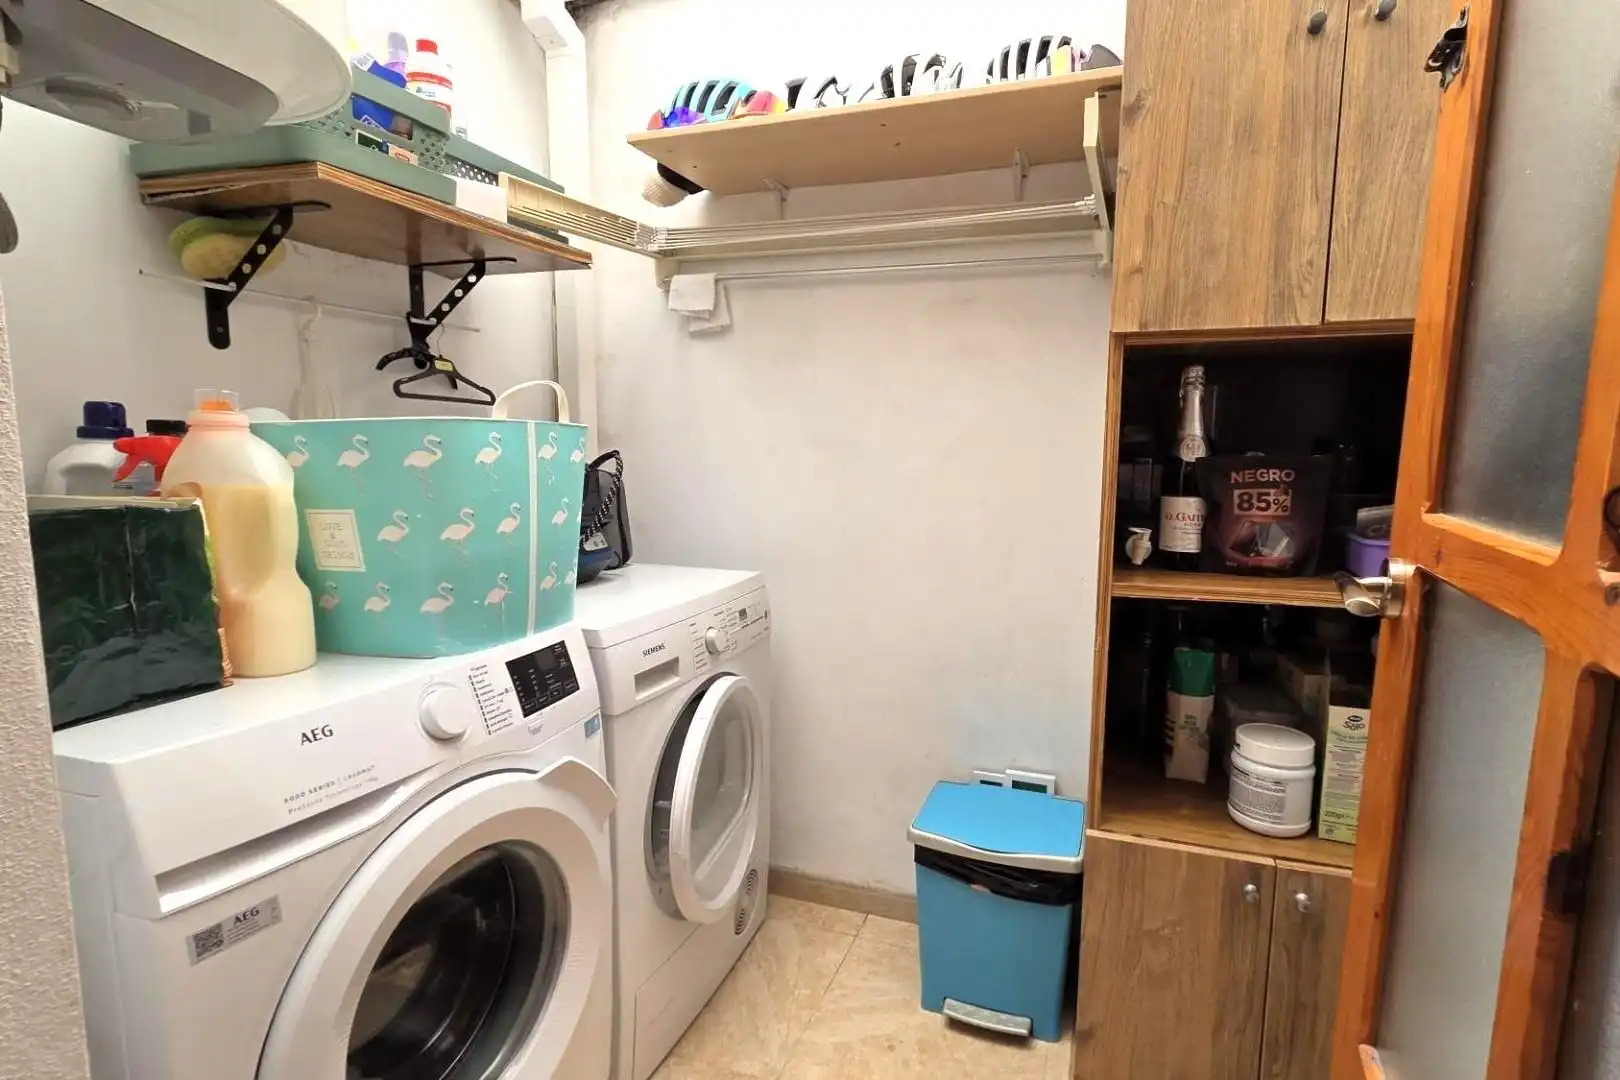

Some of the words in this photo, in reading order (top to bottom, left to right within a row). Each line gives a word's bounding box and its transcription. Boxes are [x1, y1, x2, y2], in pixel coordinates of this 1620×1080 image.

[1230, 468, 1296, 483] NEGRO
[1237, 491, 1289, 513] 85%
[642, 643, 666, 657] SIEMENS
[300, 723, 334, 746] AEG
[234, 906, 260, 926] AEG
